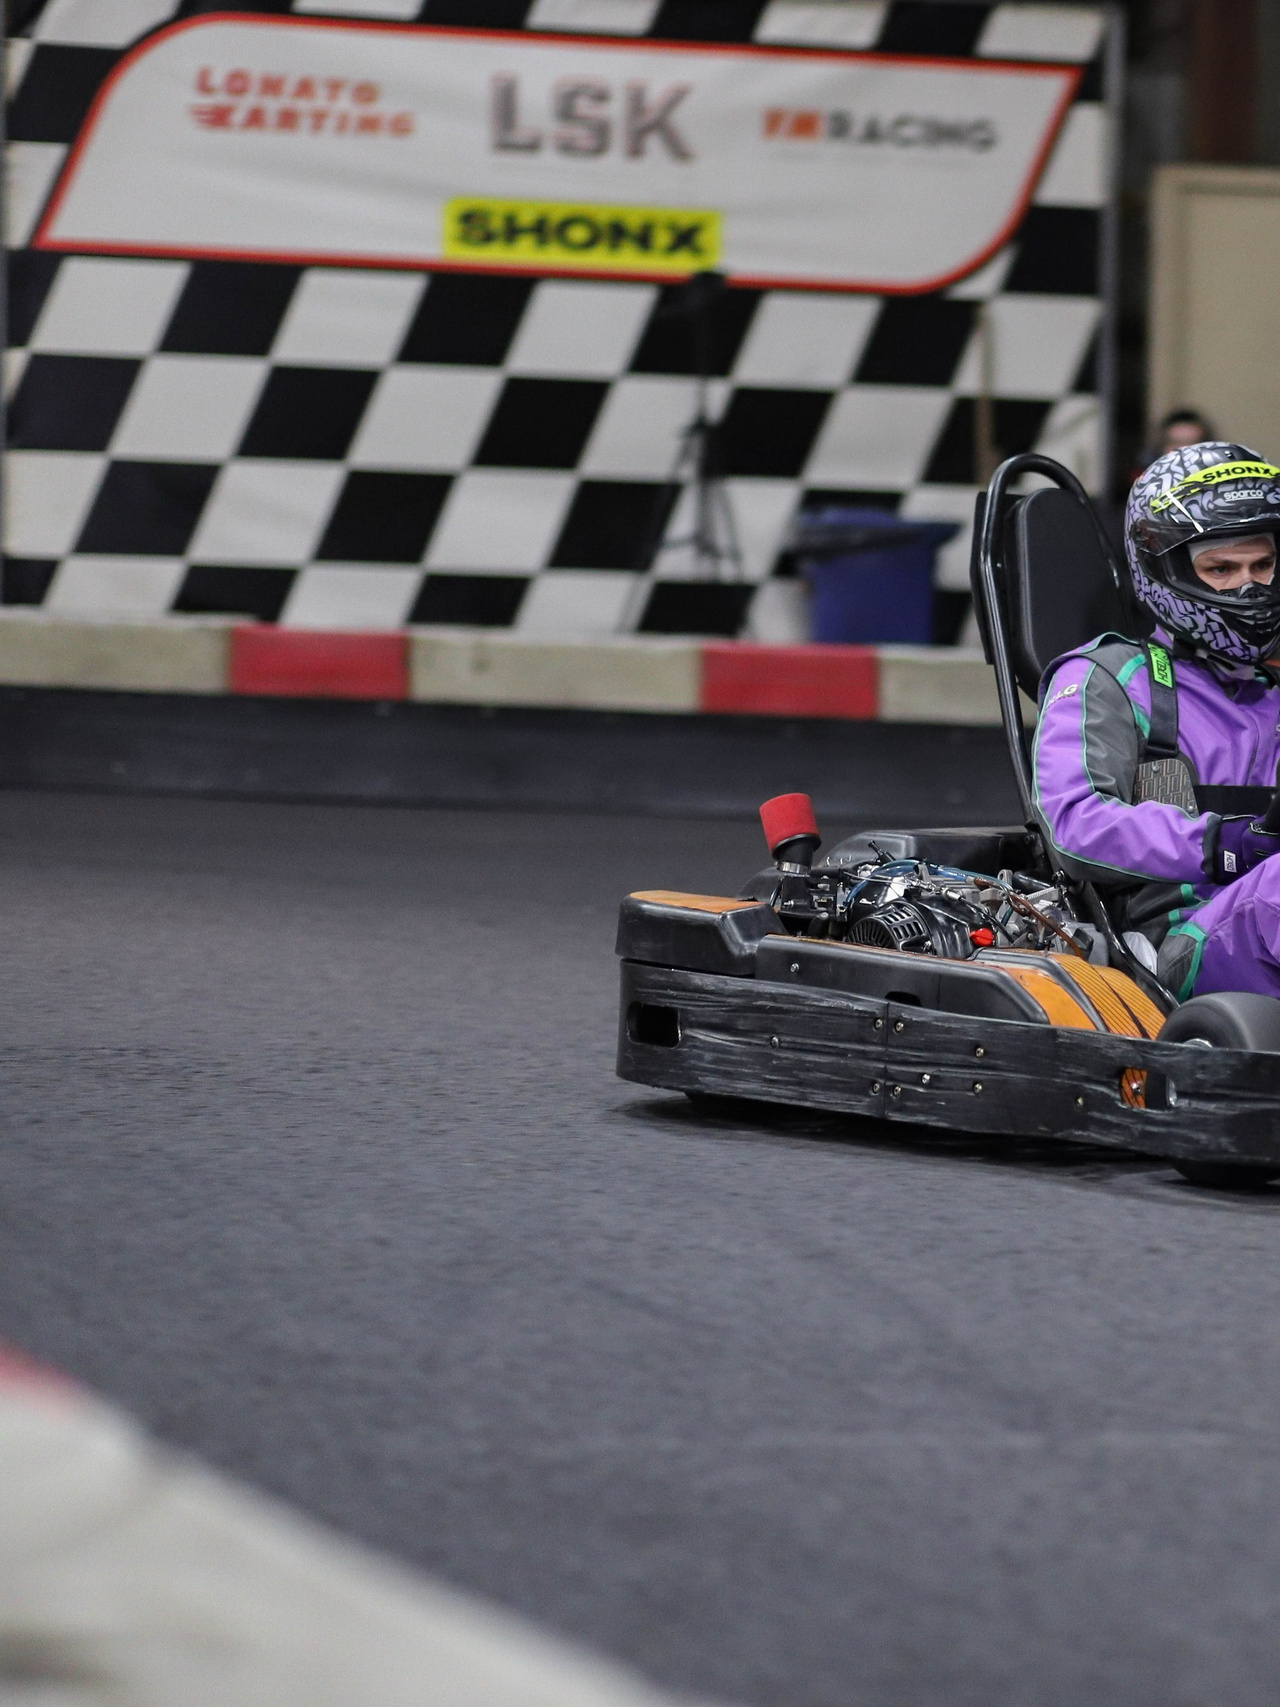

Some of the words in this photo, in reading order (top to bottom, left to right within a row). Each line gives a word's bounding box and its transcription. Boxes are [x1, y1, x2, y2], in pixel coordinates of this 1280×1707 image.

[194, 66, 381, 104] LONATO
[491, 71, 695, 164] LSK
[457, 209, 705, 256] SHONX
[1223, 489, 1265, 501] sparco
